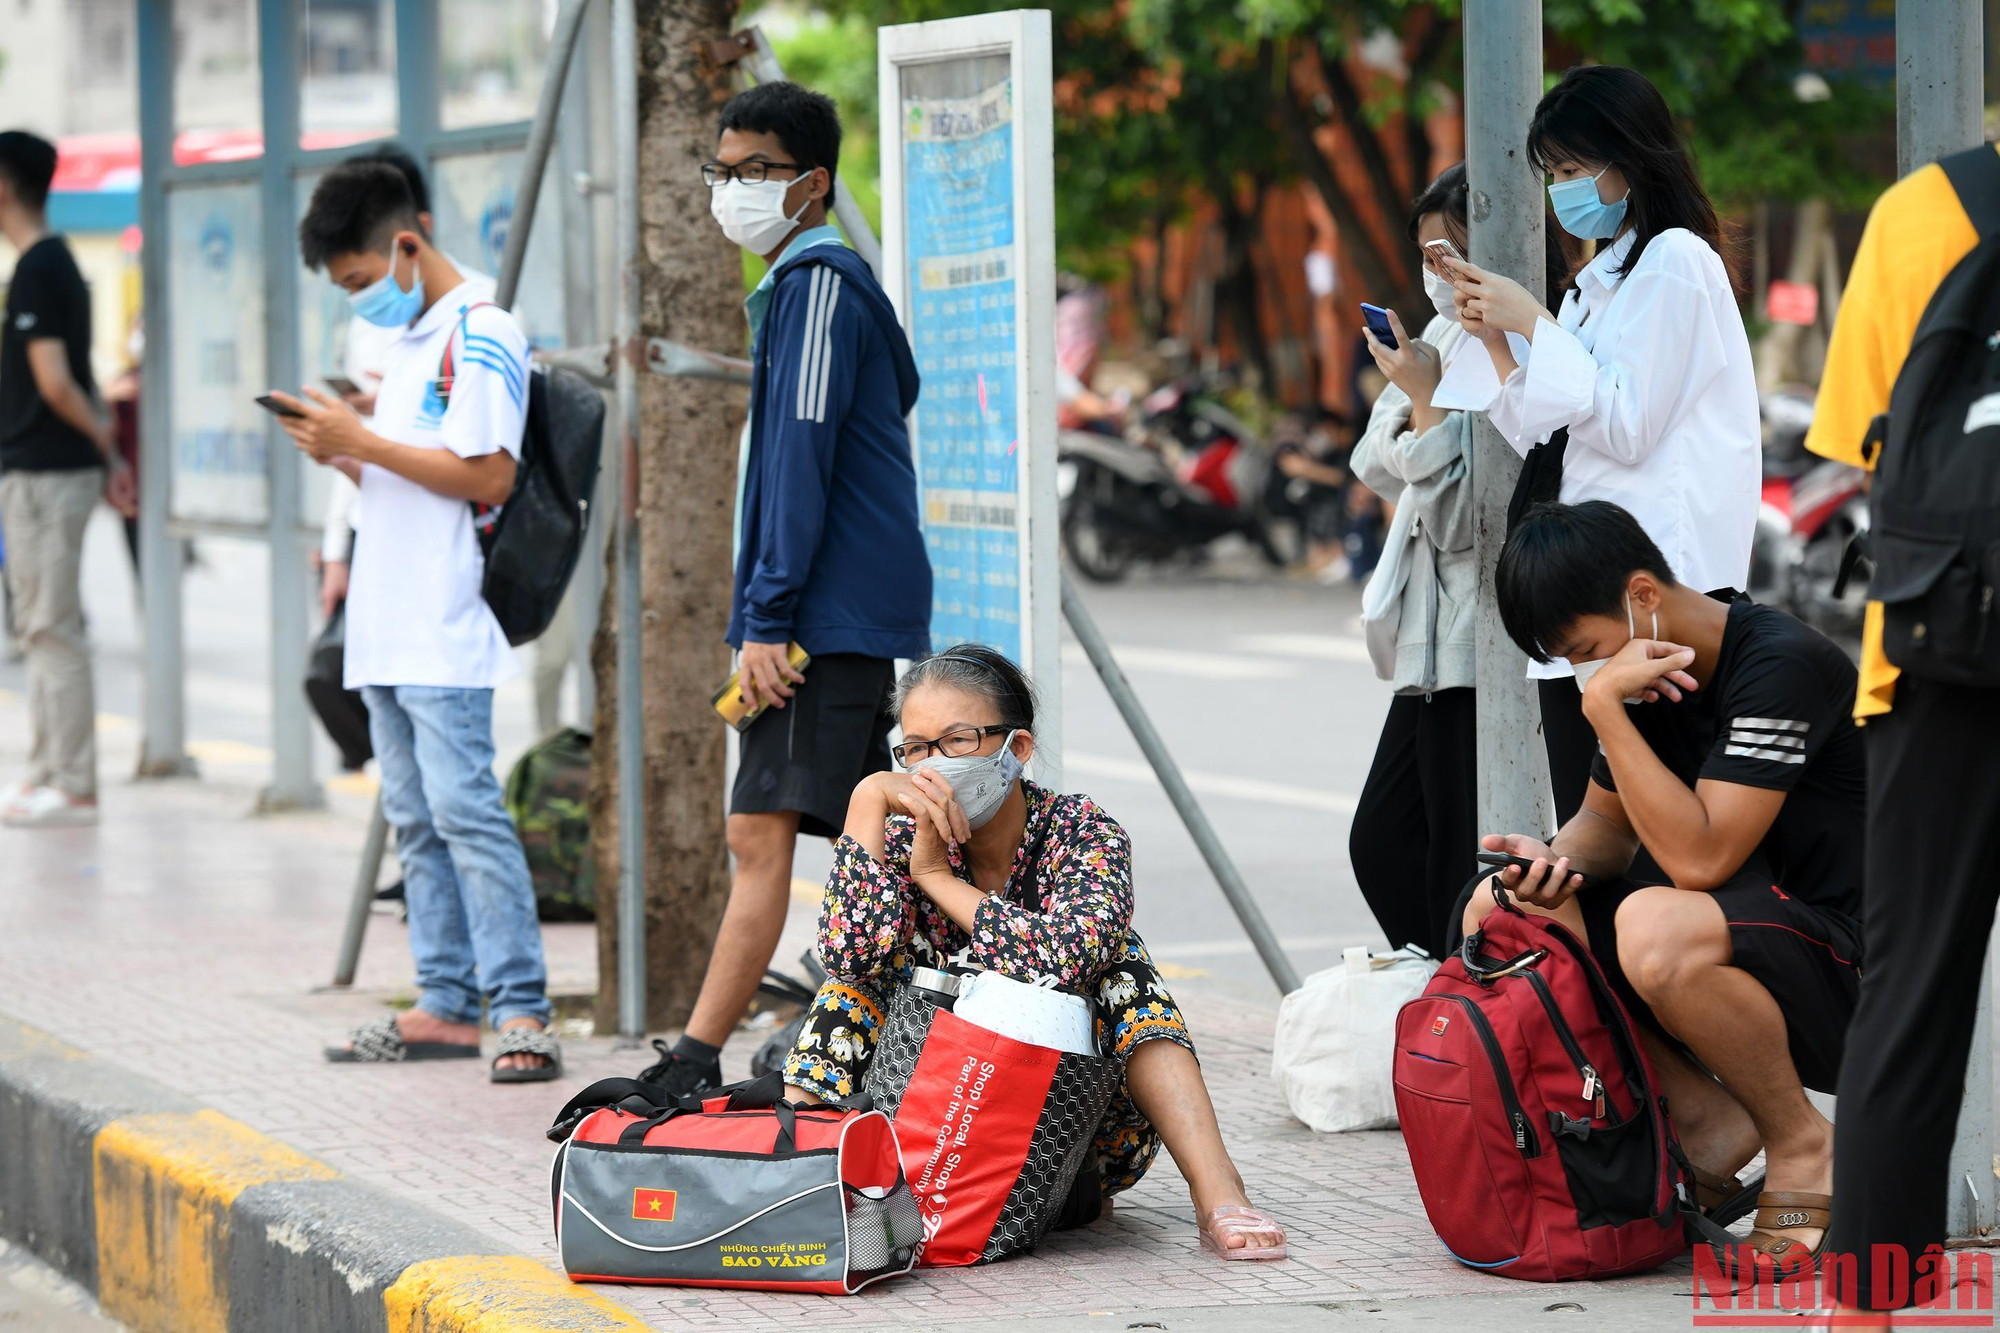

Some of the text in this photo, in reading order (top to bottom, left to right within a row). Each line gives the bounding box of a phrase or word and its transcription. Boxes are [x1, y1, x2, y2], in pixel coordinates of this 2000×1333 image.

[958, 1055, 978, 1083] Part
[968, 1061, 995, 1101] Shop
[953, 1085, 964, 1100] of
[944, 1101, 960, 1122] the
[952, 1104, 979, 1148] Local.
[914, 1125, 952, 1193] Community
[934, 1152, 961, 1190] Shop
[720, 1242, 827, 1253] NHỮNG CHIẾN BINH
[721, 1252, 827, 1267] SAO VÀNG
